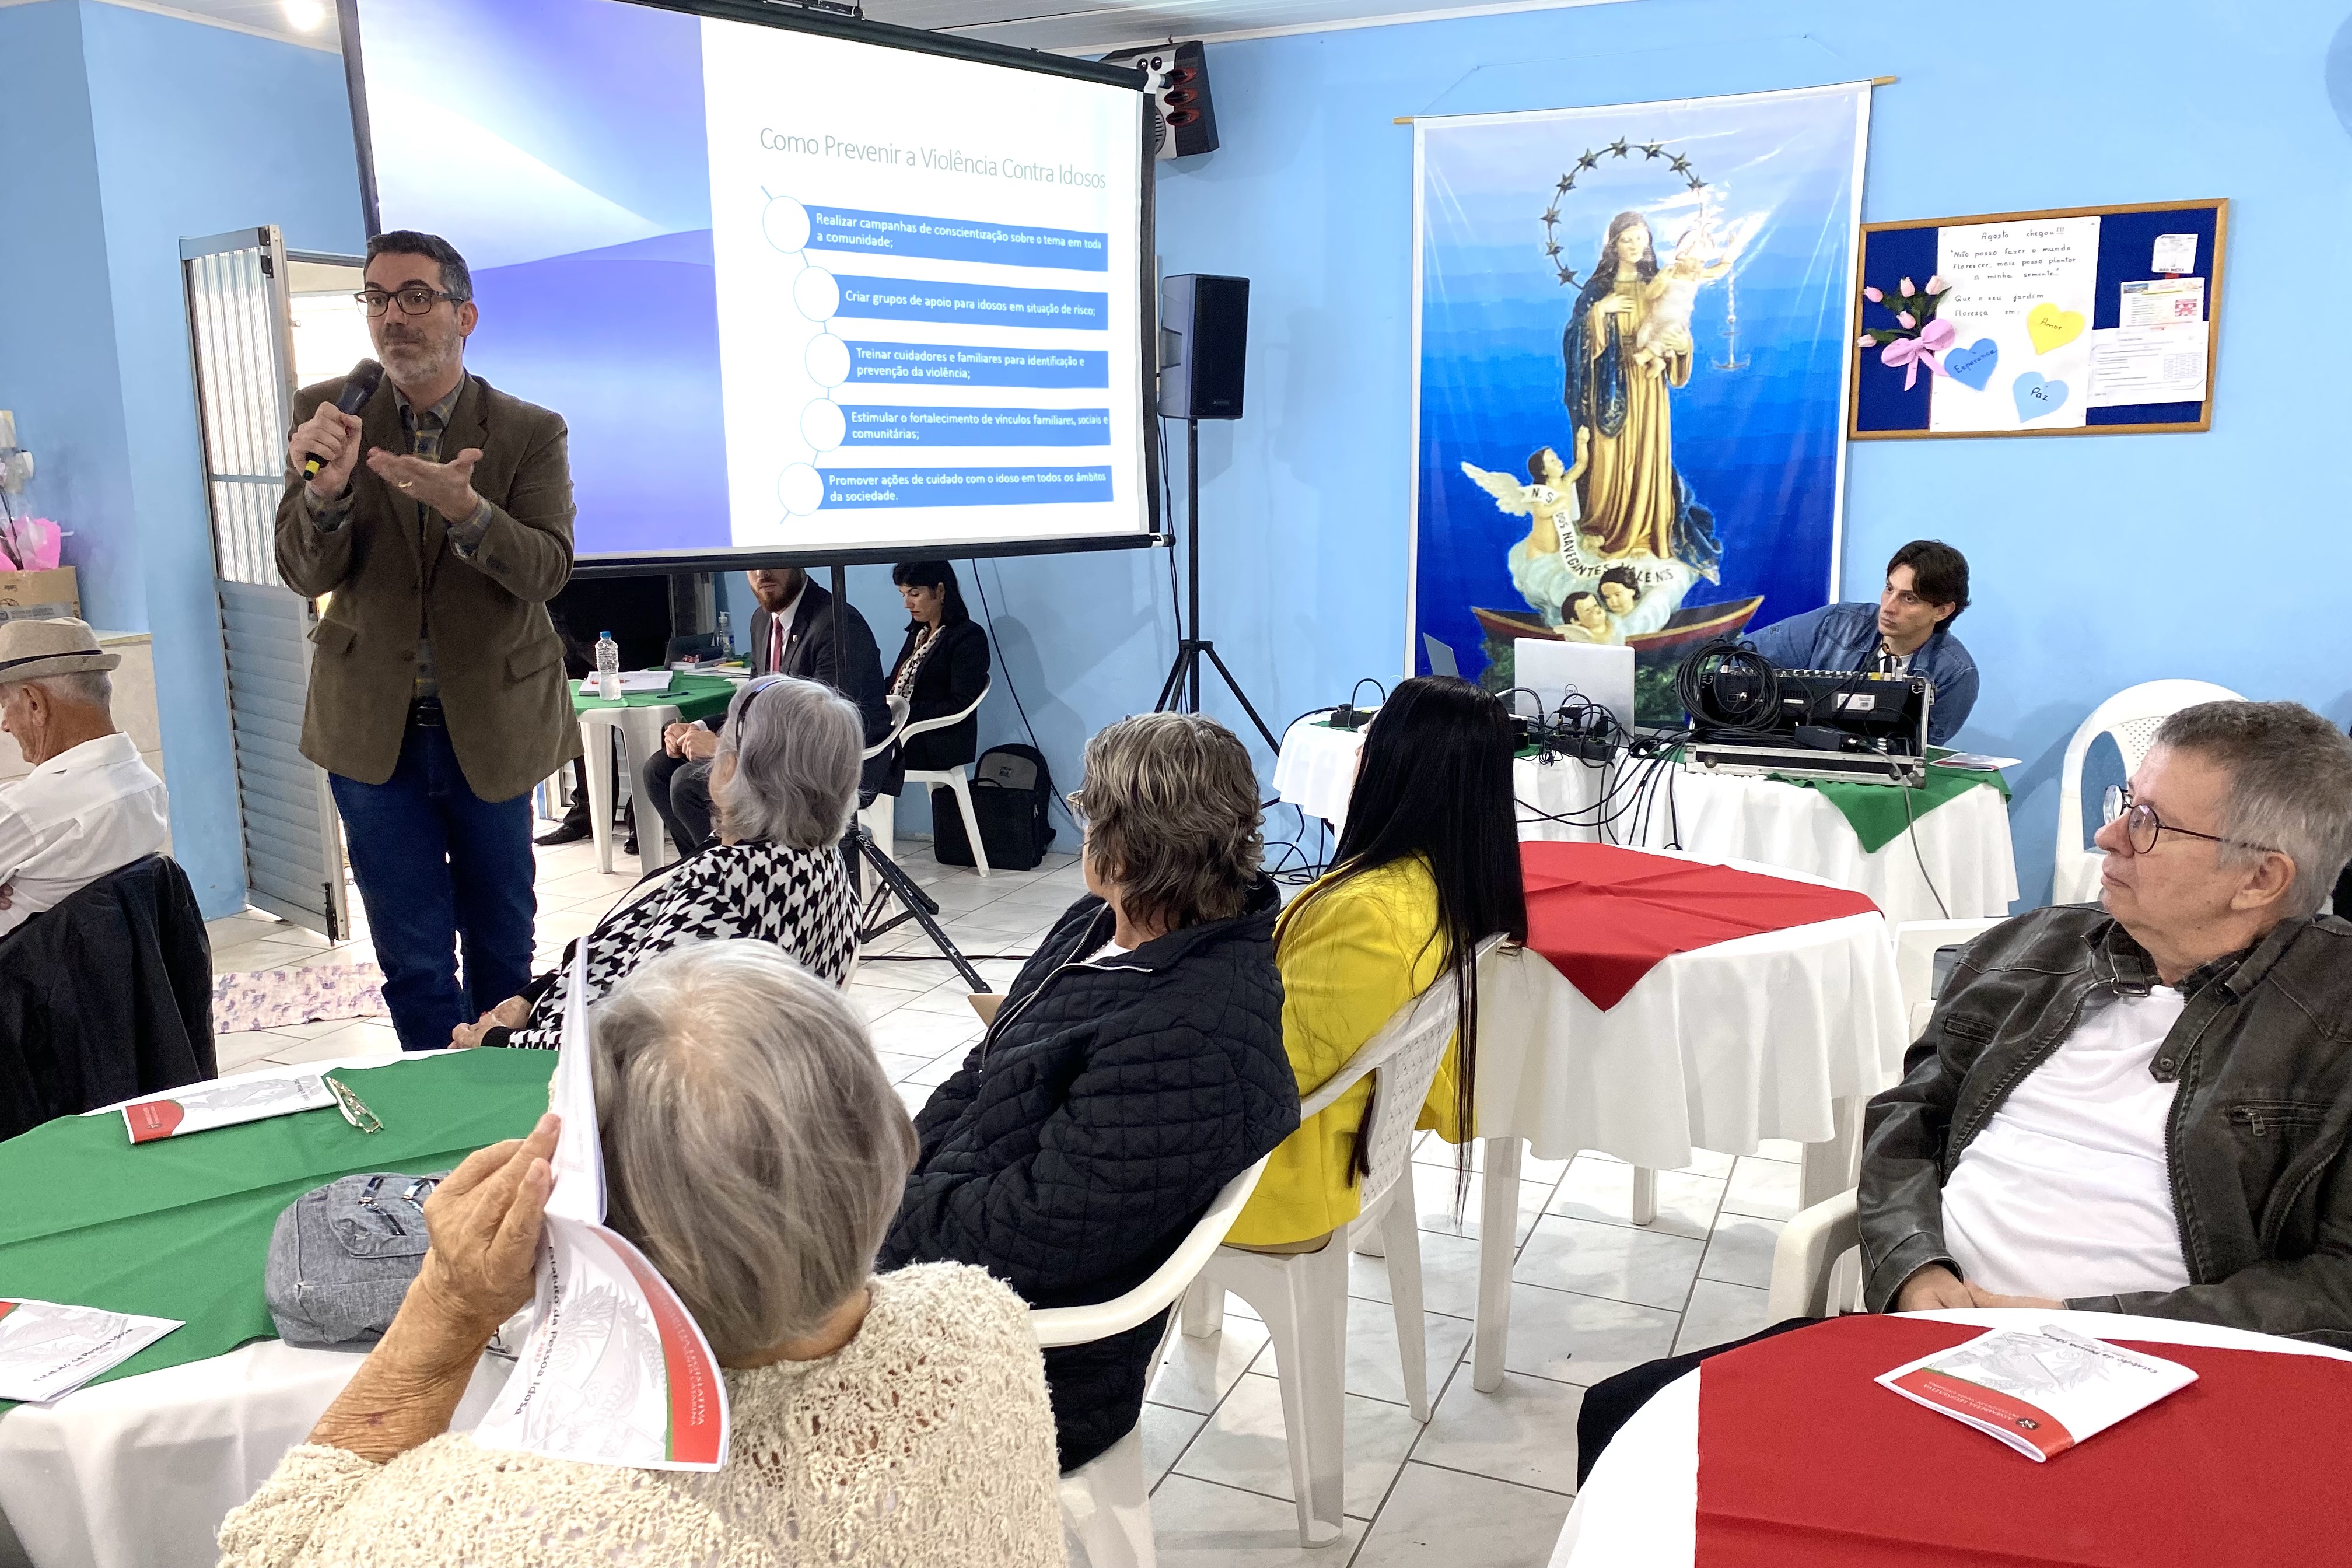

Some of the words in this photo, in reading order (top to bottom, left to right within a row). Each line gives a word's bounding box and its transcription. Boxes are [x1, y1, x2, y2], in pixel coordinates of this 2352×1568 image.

[760, 128, 819, 155] Como
[825, 135, 902, 164] Prevenir
[906, 150, 916, 166] a
[921, 147, 998, 176] Violência
[1002, 158, 1054, 183] Contra
[1059, 164, 1106, 188] Idosos
[816, 212, 858, 228] Realizar
[860, 220, 918, 233] campanhas
[919, 222, 932, 235] de
[934, 226, 1009, 243] conscientização
[1010, 232, 1035, 244] sobre
[1044, 235, 1066, 246] tema
[1068, 239, 1082, 248] em
[1084, 239, 1102, 250] toda
[1980, 230, 2009, 242] Agosto
[817, 233, 824, 242] a
[826, 233, 894, 250] comunidade;
[1975, 250, 1998, 258] posso
[2042, 244, 2071, 252] mundo
[2021, 259, 2043, 267] posso
[845, 290, 870, 302] Criar
[873, 294, 908, 307] grupos
[909, 294, 922, 306] de
[925, 296, 952, 309] apoio
[954, 300, 975, 310] para
[977, 299, 1007, 312] idosos
[1009, 303, 1024, 312] em
[1026, 302, 1059, 316] situação
[1061, 303, 1072, 314] de
[1073, 305, 1096, 317] risco;
[2013, 293, 2044, 302] jardim
[2040, 317, 2063, 330] Amor
[856, 348, 891, 359] Treinar
[894, 349, 947, 362] cuidadores
[949, 354, 956, 362] e
[957, 351, 1002, 365] familiares
[1005, 356, 1026, 367] para
[1027, 355, 1078, 369] identificação
[1079, 358, 1085, 366] e
[1954, 349, 1998, 374] Esperança
[857, 365, 909, 379] prevenção
[911, 366, 923, 377] da
[926, 367, 971, 380] violência;
[2030, 387, 2049, 401] Paz
[851, 411, 899, 423] Estimular
[901, 415, 908, 424] o
[909, 412, 980, 424] fortalecimento
[981, 413, 993, 424] de
[995, 414, 1031, 425] vínculos
[1033, 414, 1077, 426] familiares,
[1077, 414, 1102, 425] sociais
[1103, 416, 1108, 424] e
[852, 428, 920, 440] comunitárias;
[829, 474, 880, 486] Promover
[881, 474, 909, 488] ações
[911, 474, 924, 485] de
[926, 473, 964, 485] cuidado
[965, 475, 985, 484] com
[987, 475, 994, 484] o
[996, 473, 1020, 484] idoso
[1021, 474, 1035, 483] em
[1037, 472, 1062, 483] todos
[1063, 474, 1074, 482] os
[1076, 471, 1107, 482] âmbitos
[830, 490, 843, 502] da
[845, 489, 899, 502] sociedade.
[548, 1246, 559, 1304] Estatuto
[552, 1309, 561, 1326] da
[537, 1331, 558, 1377] Pessoa
[514, 1382, 541, 1415] Idosa
